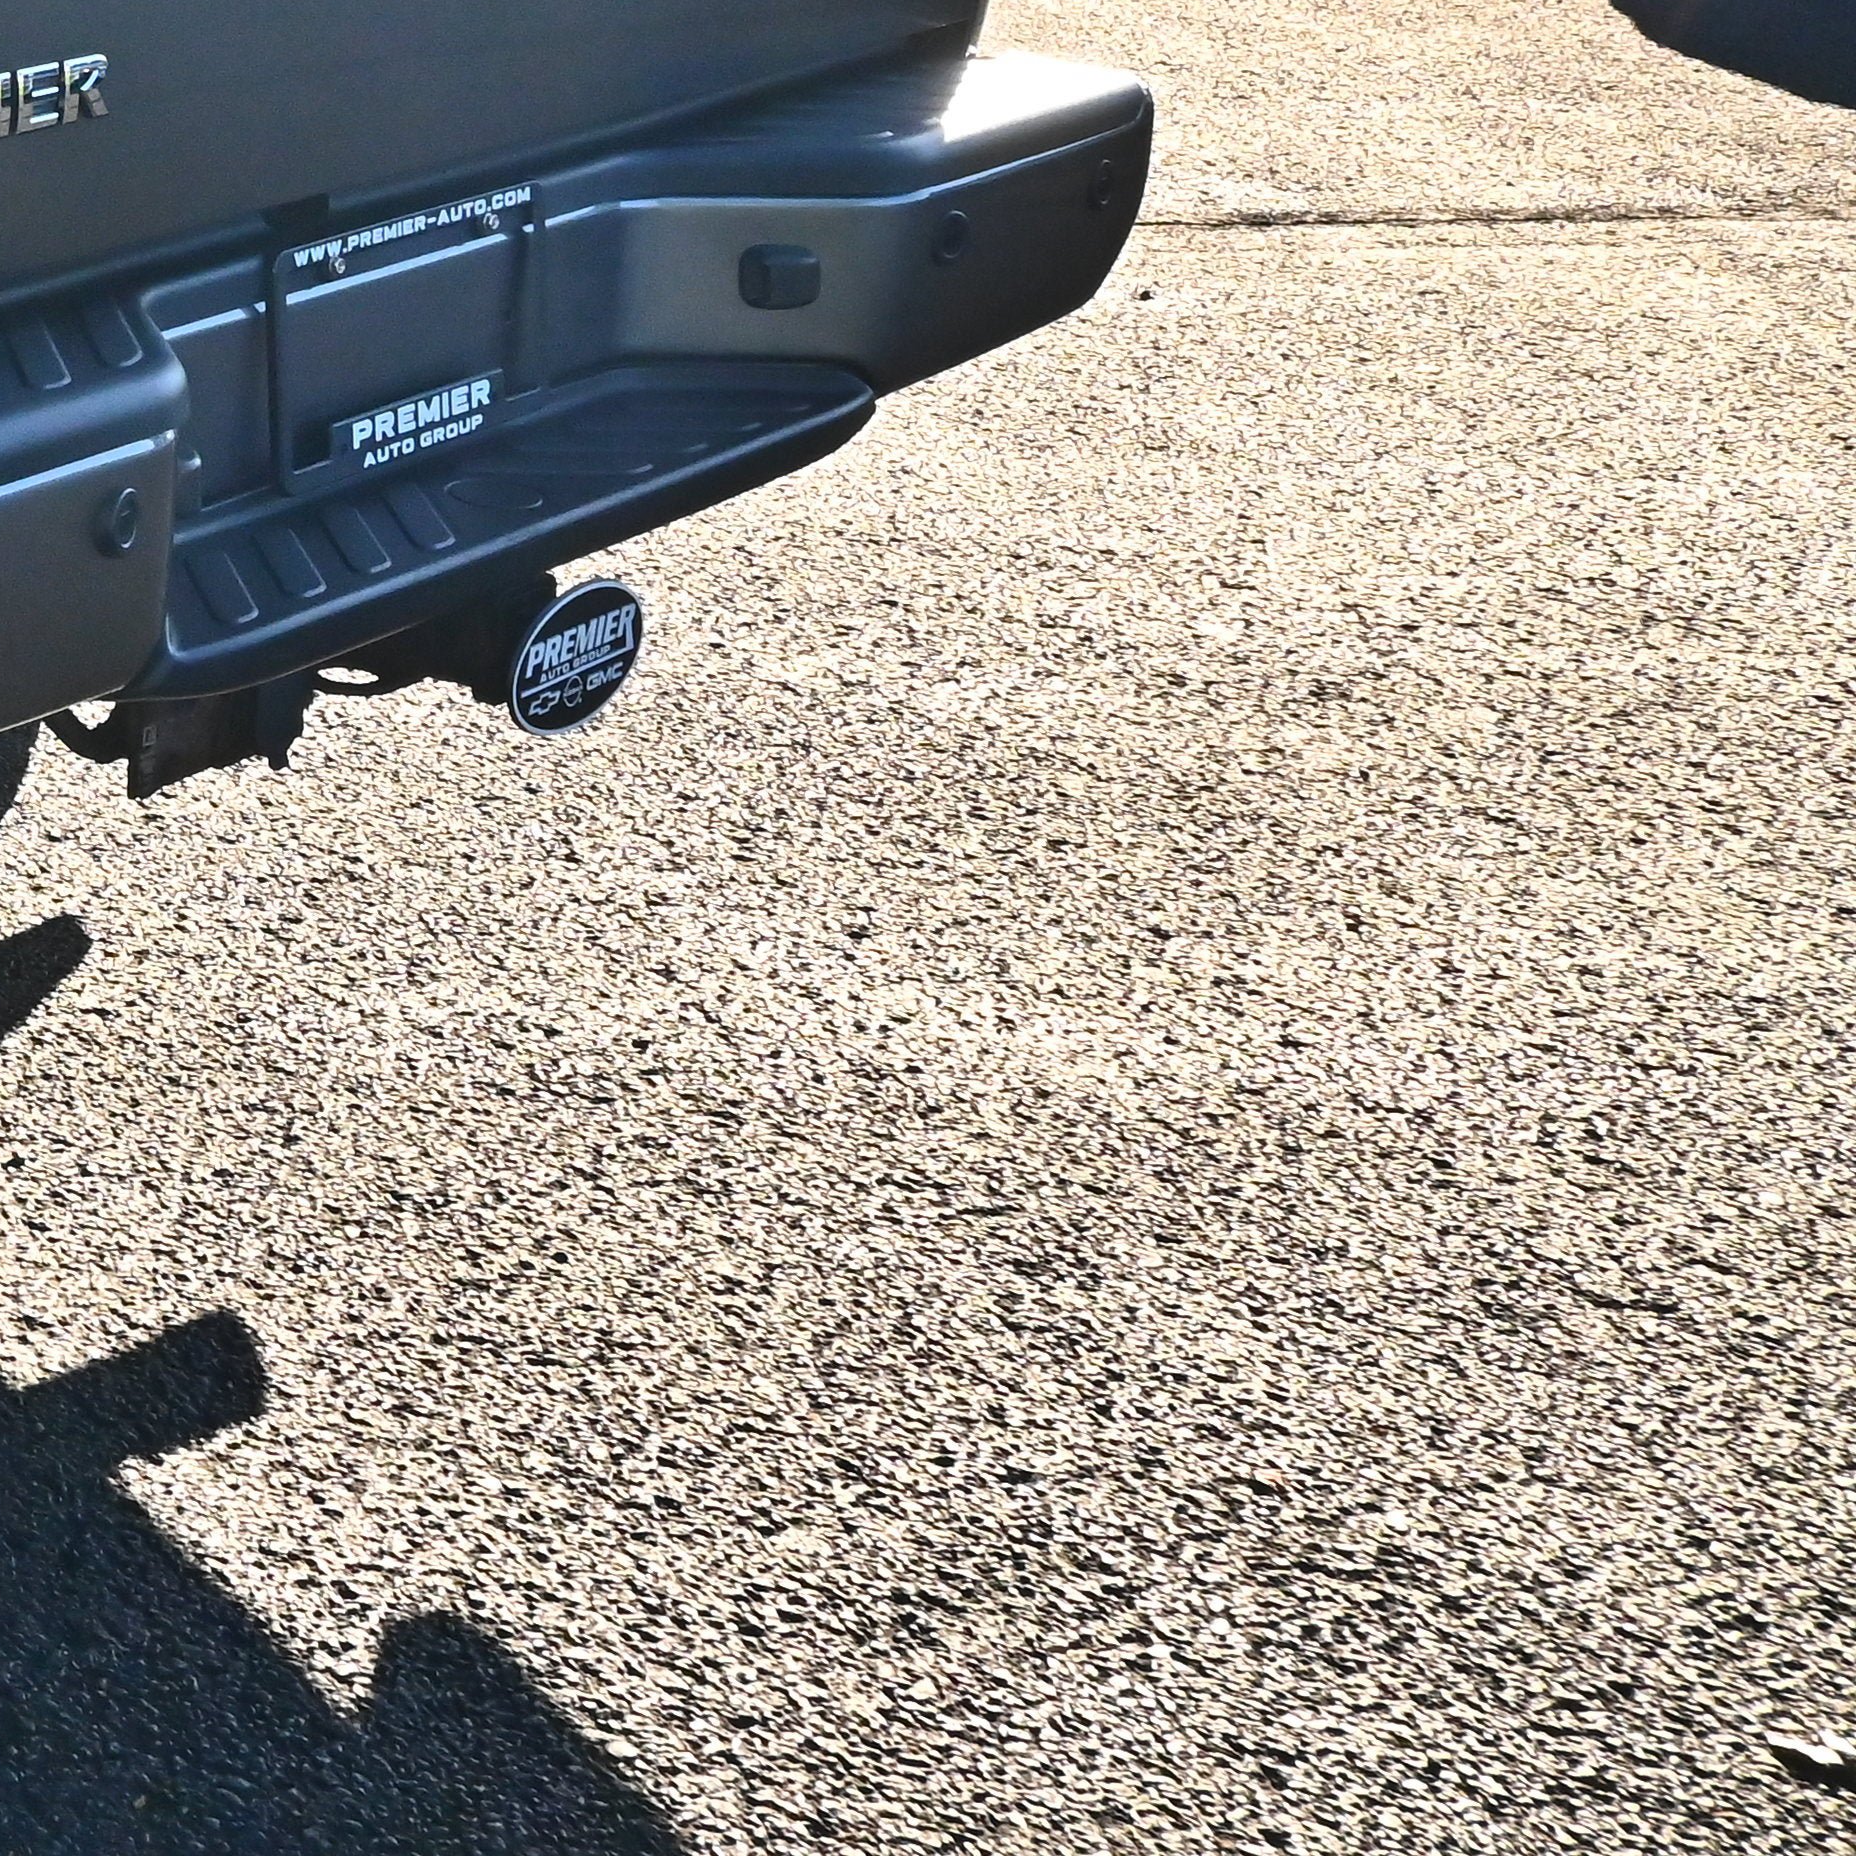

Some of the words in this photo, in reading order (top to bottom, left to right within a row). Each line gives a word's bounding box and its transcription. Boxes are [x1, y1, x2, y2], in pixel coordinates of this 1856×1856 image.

[293, 186, 532, 268] WWW.PREMIER-AUTO.COM
[352, 379, 491, 450] PREMIER
[363, 437, 416, 469] AUTO
[419, 413, 484, 448] GROUP
[525, 602, 637, 680] PREMIER
[540, 662, 571, 683] AUTO
[572, 644, 612, 670] GROUP
[586, 661, 624, 691] GMC
